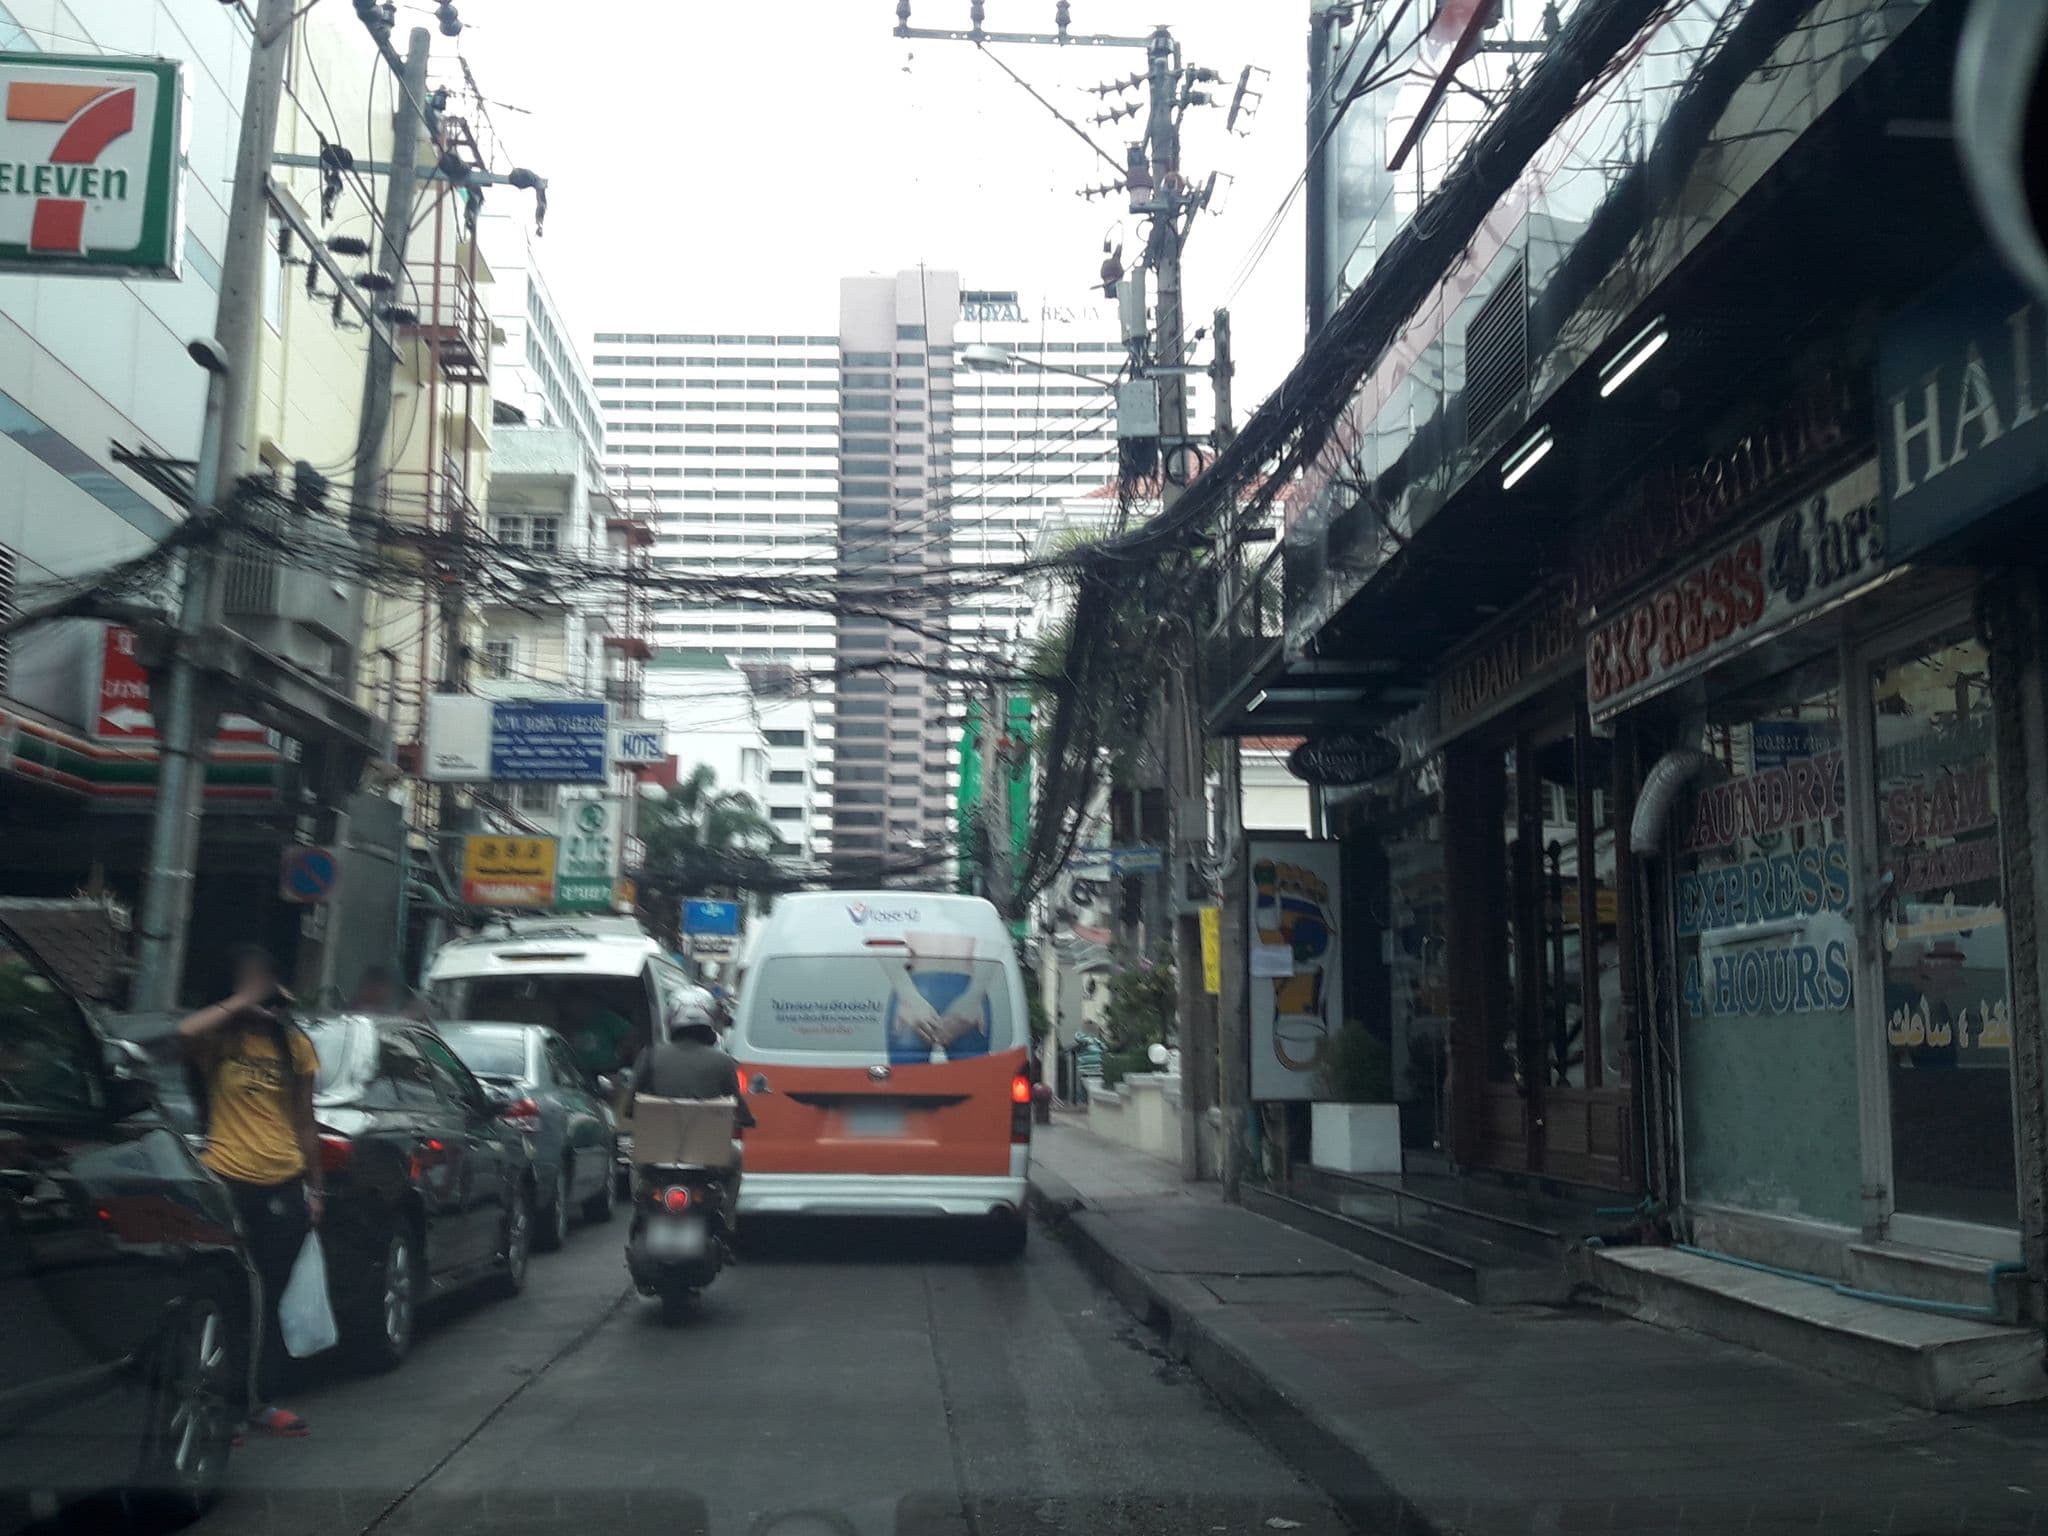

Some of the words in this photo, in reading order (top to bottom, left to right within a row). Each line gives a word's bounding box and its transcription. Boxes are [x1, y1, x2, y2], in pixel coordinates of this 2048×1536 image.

[963, 302, 1028, 323] ROYAL
[1591, 537, 1764, 704] EXPRESS
[1680, 752, 1843, 852] AUNDRY
[1887, 757, 1995, 847] SIAM
[1678, 842, 1851, 936] EXPRESS
[1712, 939, 1851, 1016] HOURS
